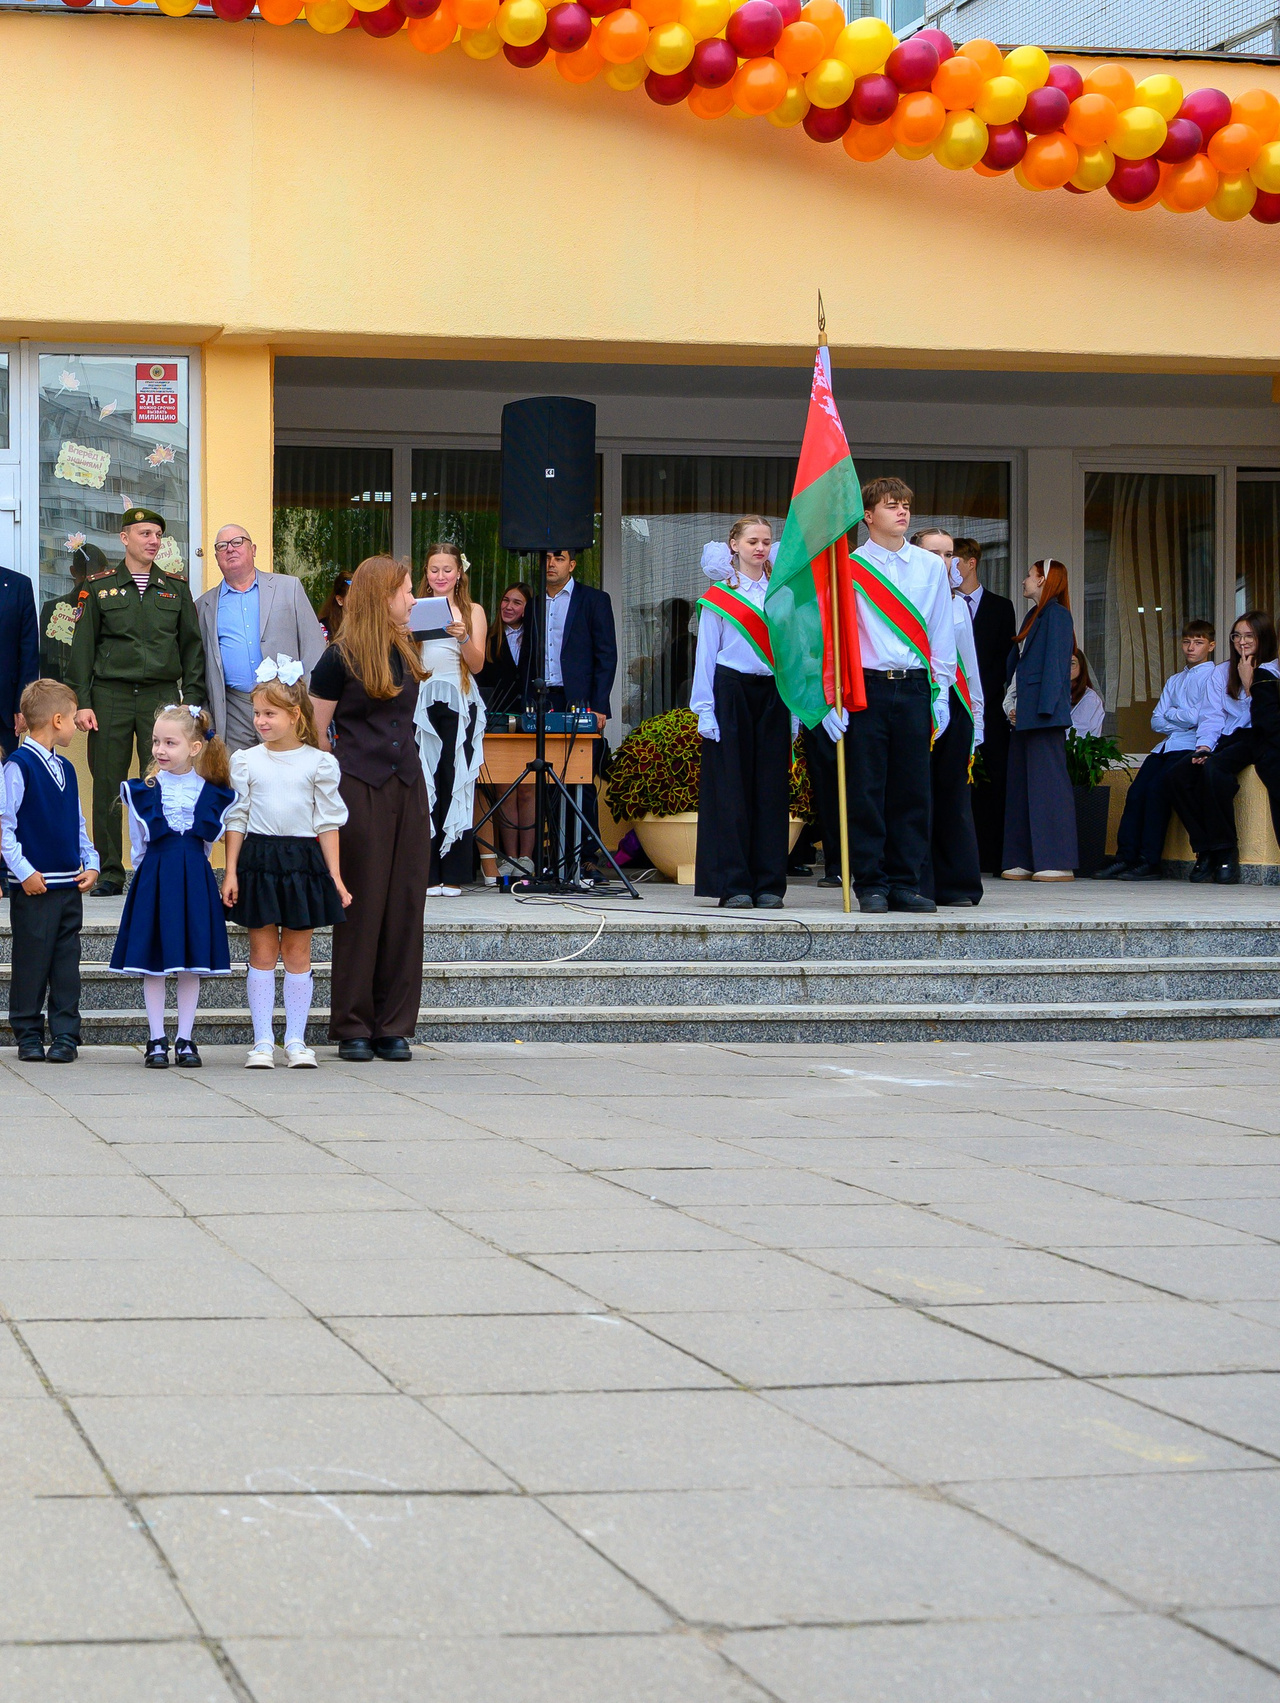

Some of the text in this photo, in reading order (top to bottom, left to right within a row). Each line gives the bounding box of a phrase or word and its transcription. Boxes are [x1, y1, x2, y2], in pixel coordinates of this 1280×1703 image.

[139, 394, 176, 405] ЗДЕСЬ
[68, 444, 99, 461] Вперёд
[67, 456, 103, 470] знаниям!
